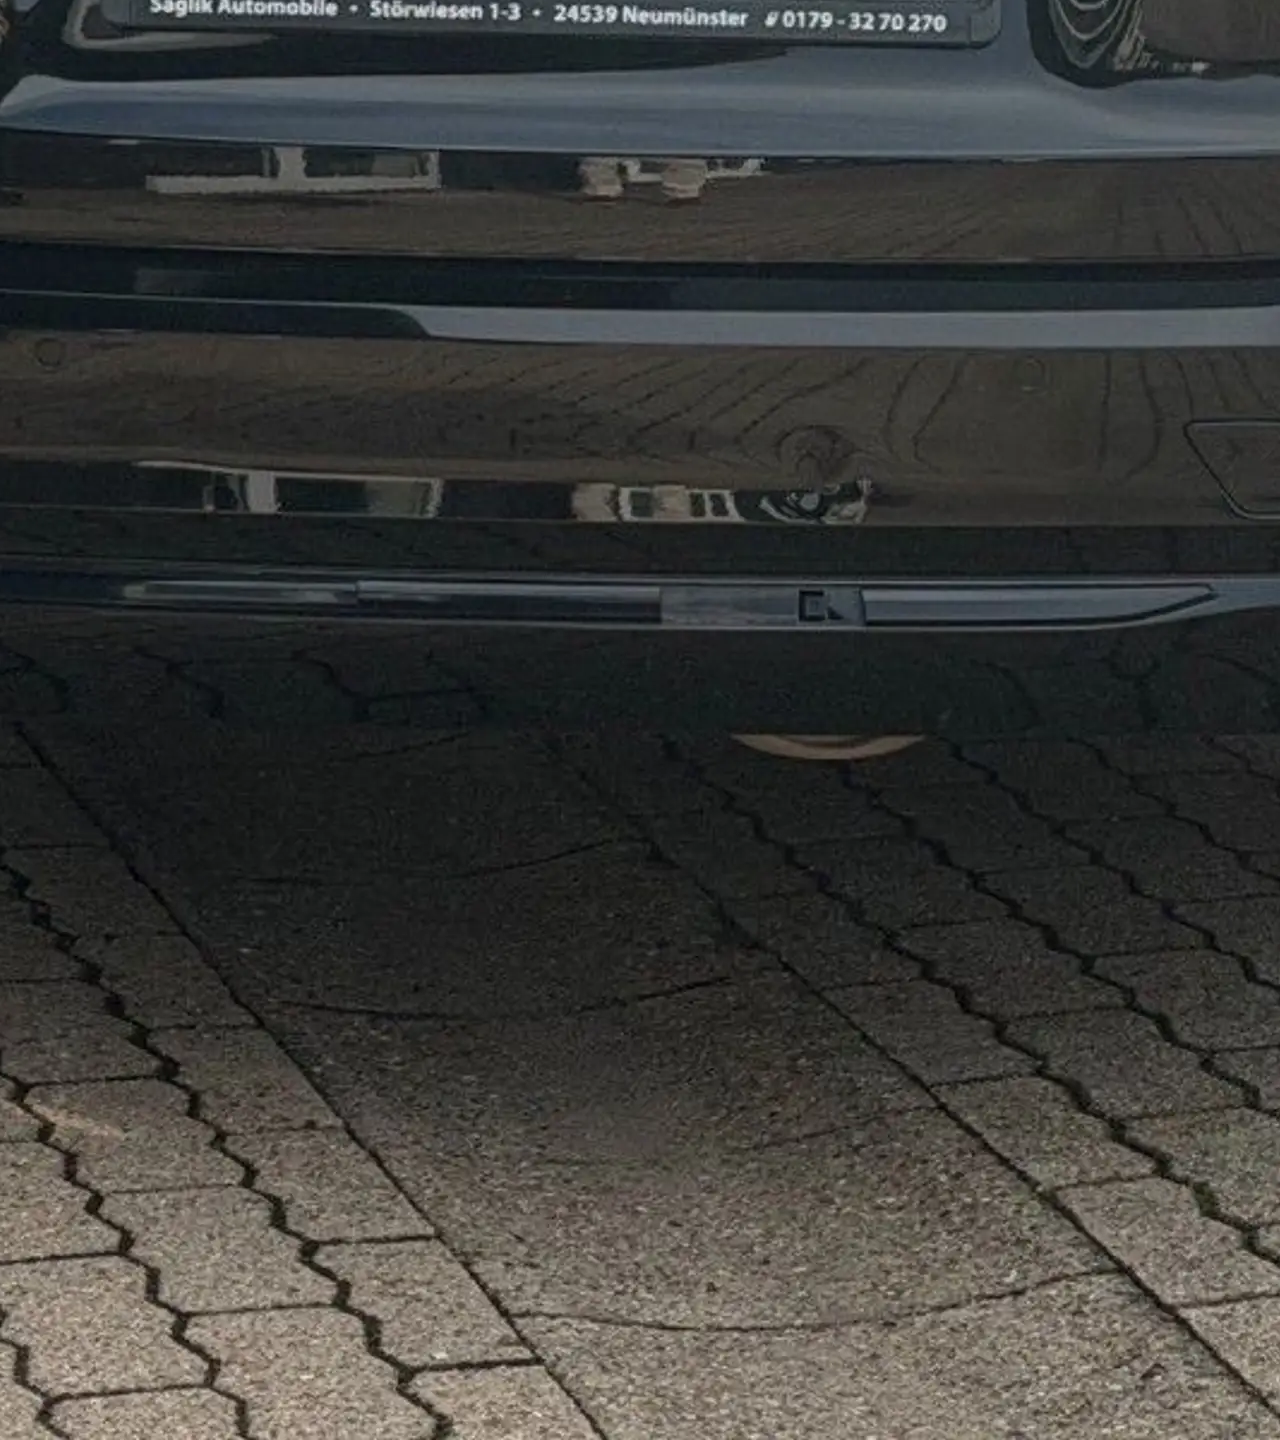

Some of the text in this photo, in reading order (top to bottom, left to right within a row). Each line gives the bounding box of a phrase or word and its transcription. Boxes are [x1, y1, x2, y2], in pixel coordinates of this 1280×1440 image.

[490, 2, 522, 21] 1-3
[553, 4, 618, 24] 24539
[622, 6, 749, 27] Neumünster
[782, 9, 833, 29] 0179
